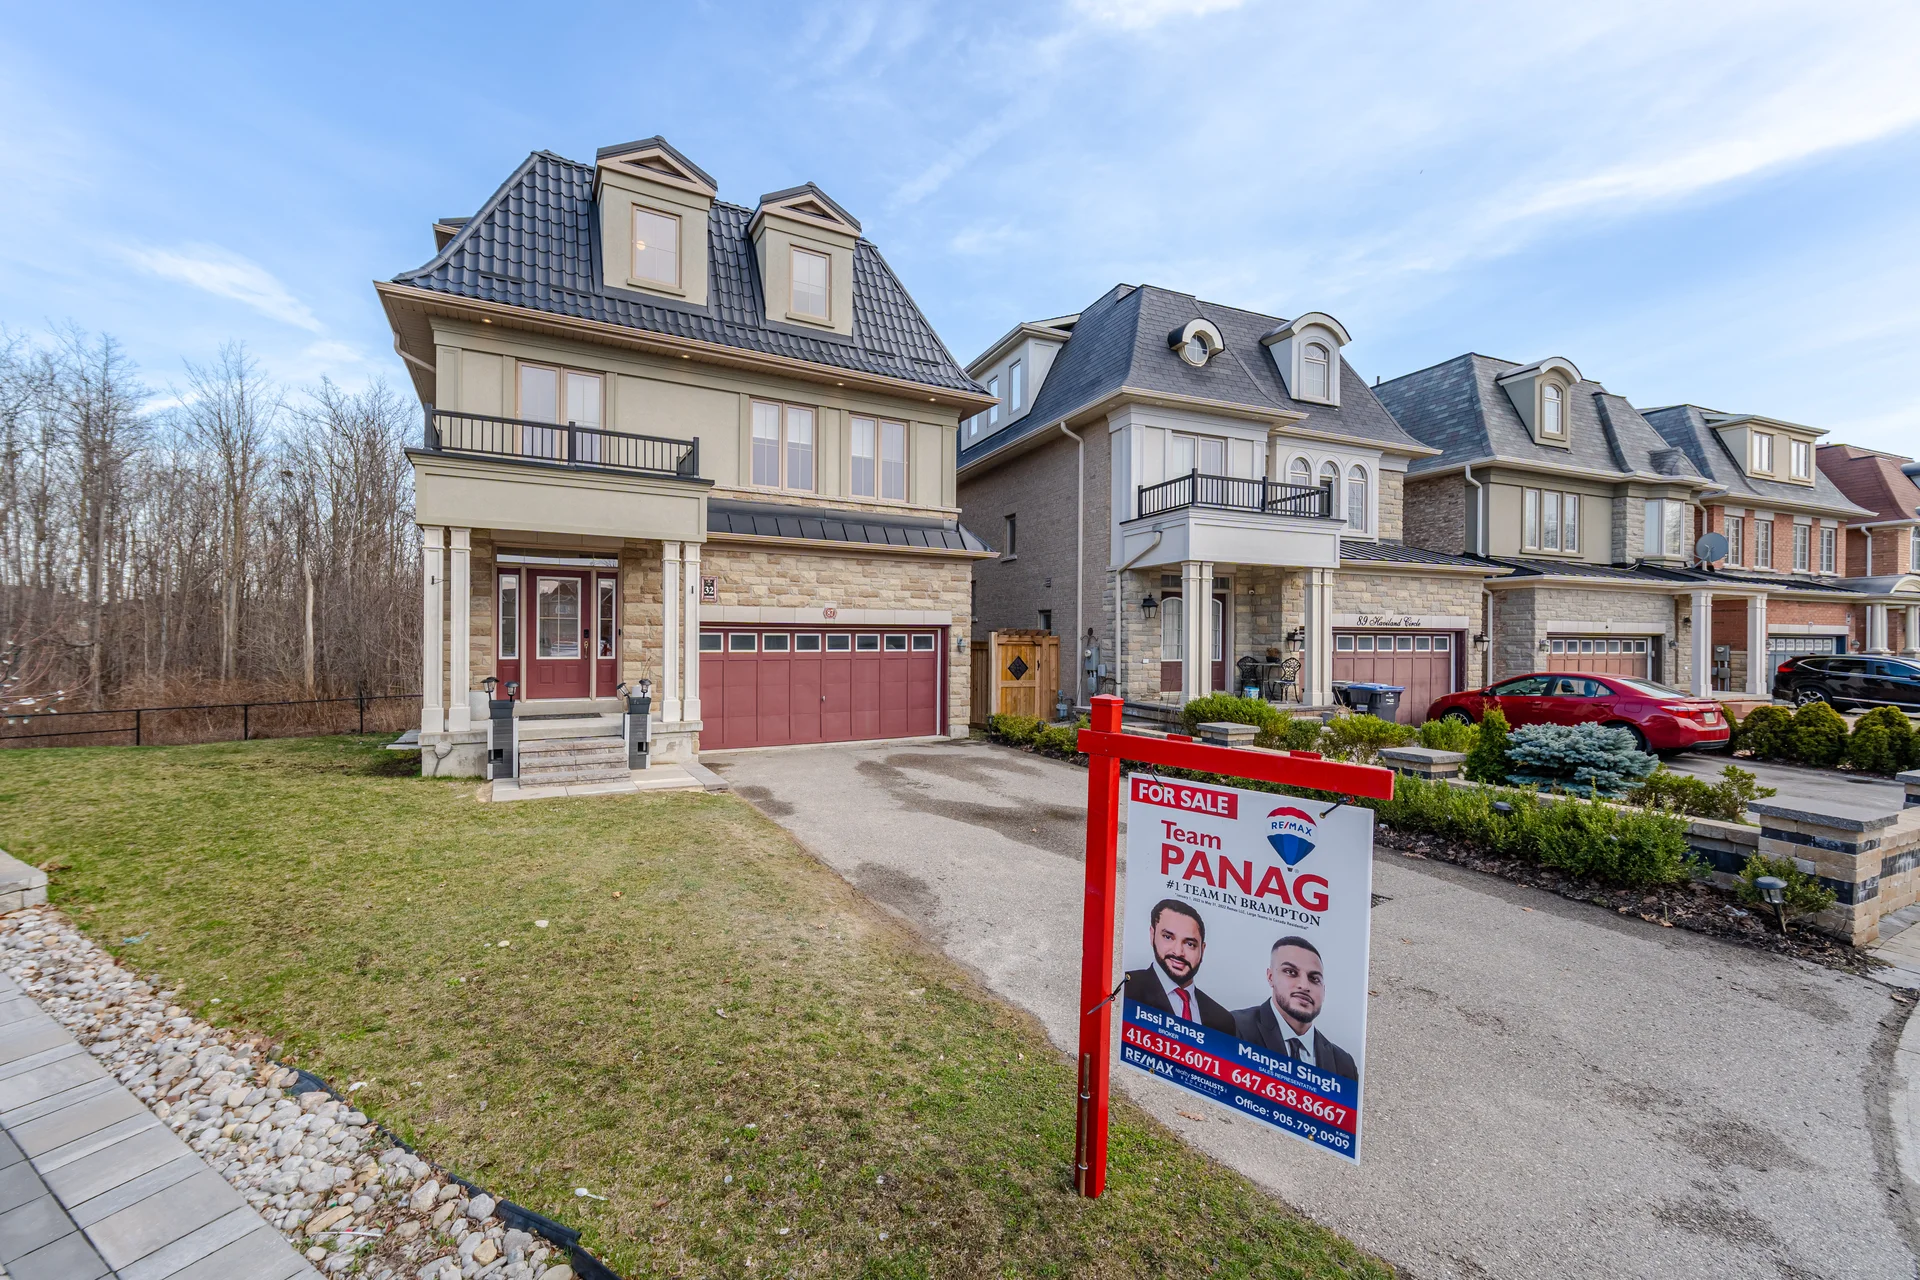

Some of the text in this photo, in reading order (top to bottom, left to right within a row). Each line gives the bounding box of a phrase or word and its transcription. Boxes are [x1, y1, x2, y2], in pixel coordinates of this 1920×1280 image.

[704, 586, 714, 595] 32
[1357, 616, 1421, 627] 89 Haviland Circle
[1138, 782, 1229, 815] FOR SALE
[1161, 819, 1222, 850] Team
[1271, 821, 1312, 837] RE/MAX
[1161, 842, 1329, 912] PANAG
[1166, 879, 1321, 927] #1 TEAM IN BRAMPTON
[1135, 1005, 1205, 1044] Jassi Panag
[1157, 1027, 1179, 1040] BROKER
[1125, 1046, 1174, 1076] RE/MAX
[1126, 1027, 1221, 1077] 416.312.6071
[1190, 1073, 1224, 1092] SPECIALISTS
[1238, 1043, 1341, 1094] Manpal Singh
[1258, 1066, 1318, 1093] SALES REPRESENTATIVE
[1231, 1069, 1347, 1125] 647.638.8667
[1235, 1095, 1350, 1150] Office: 905.799.0909
